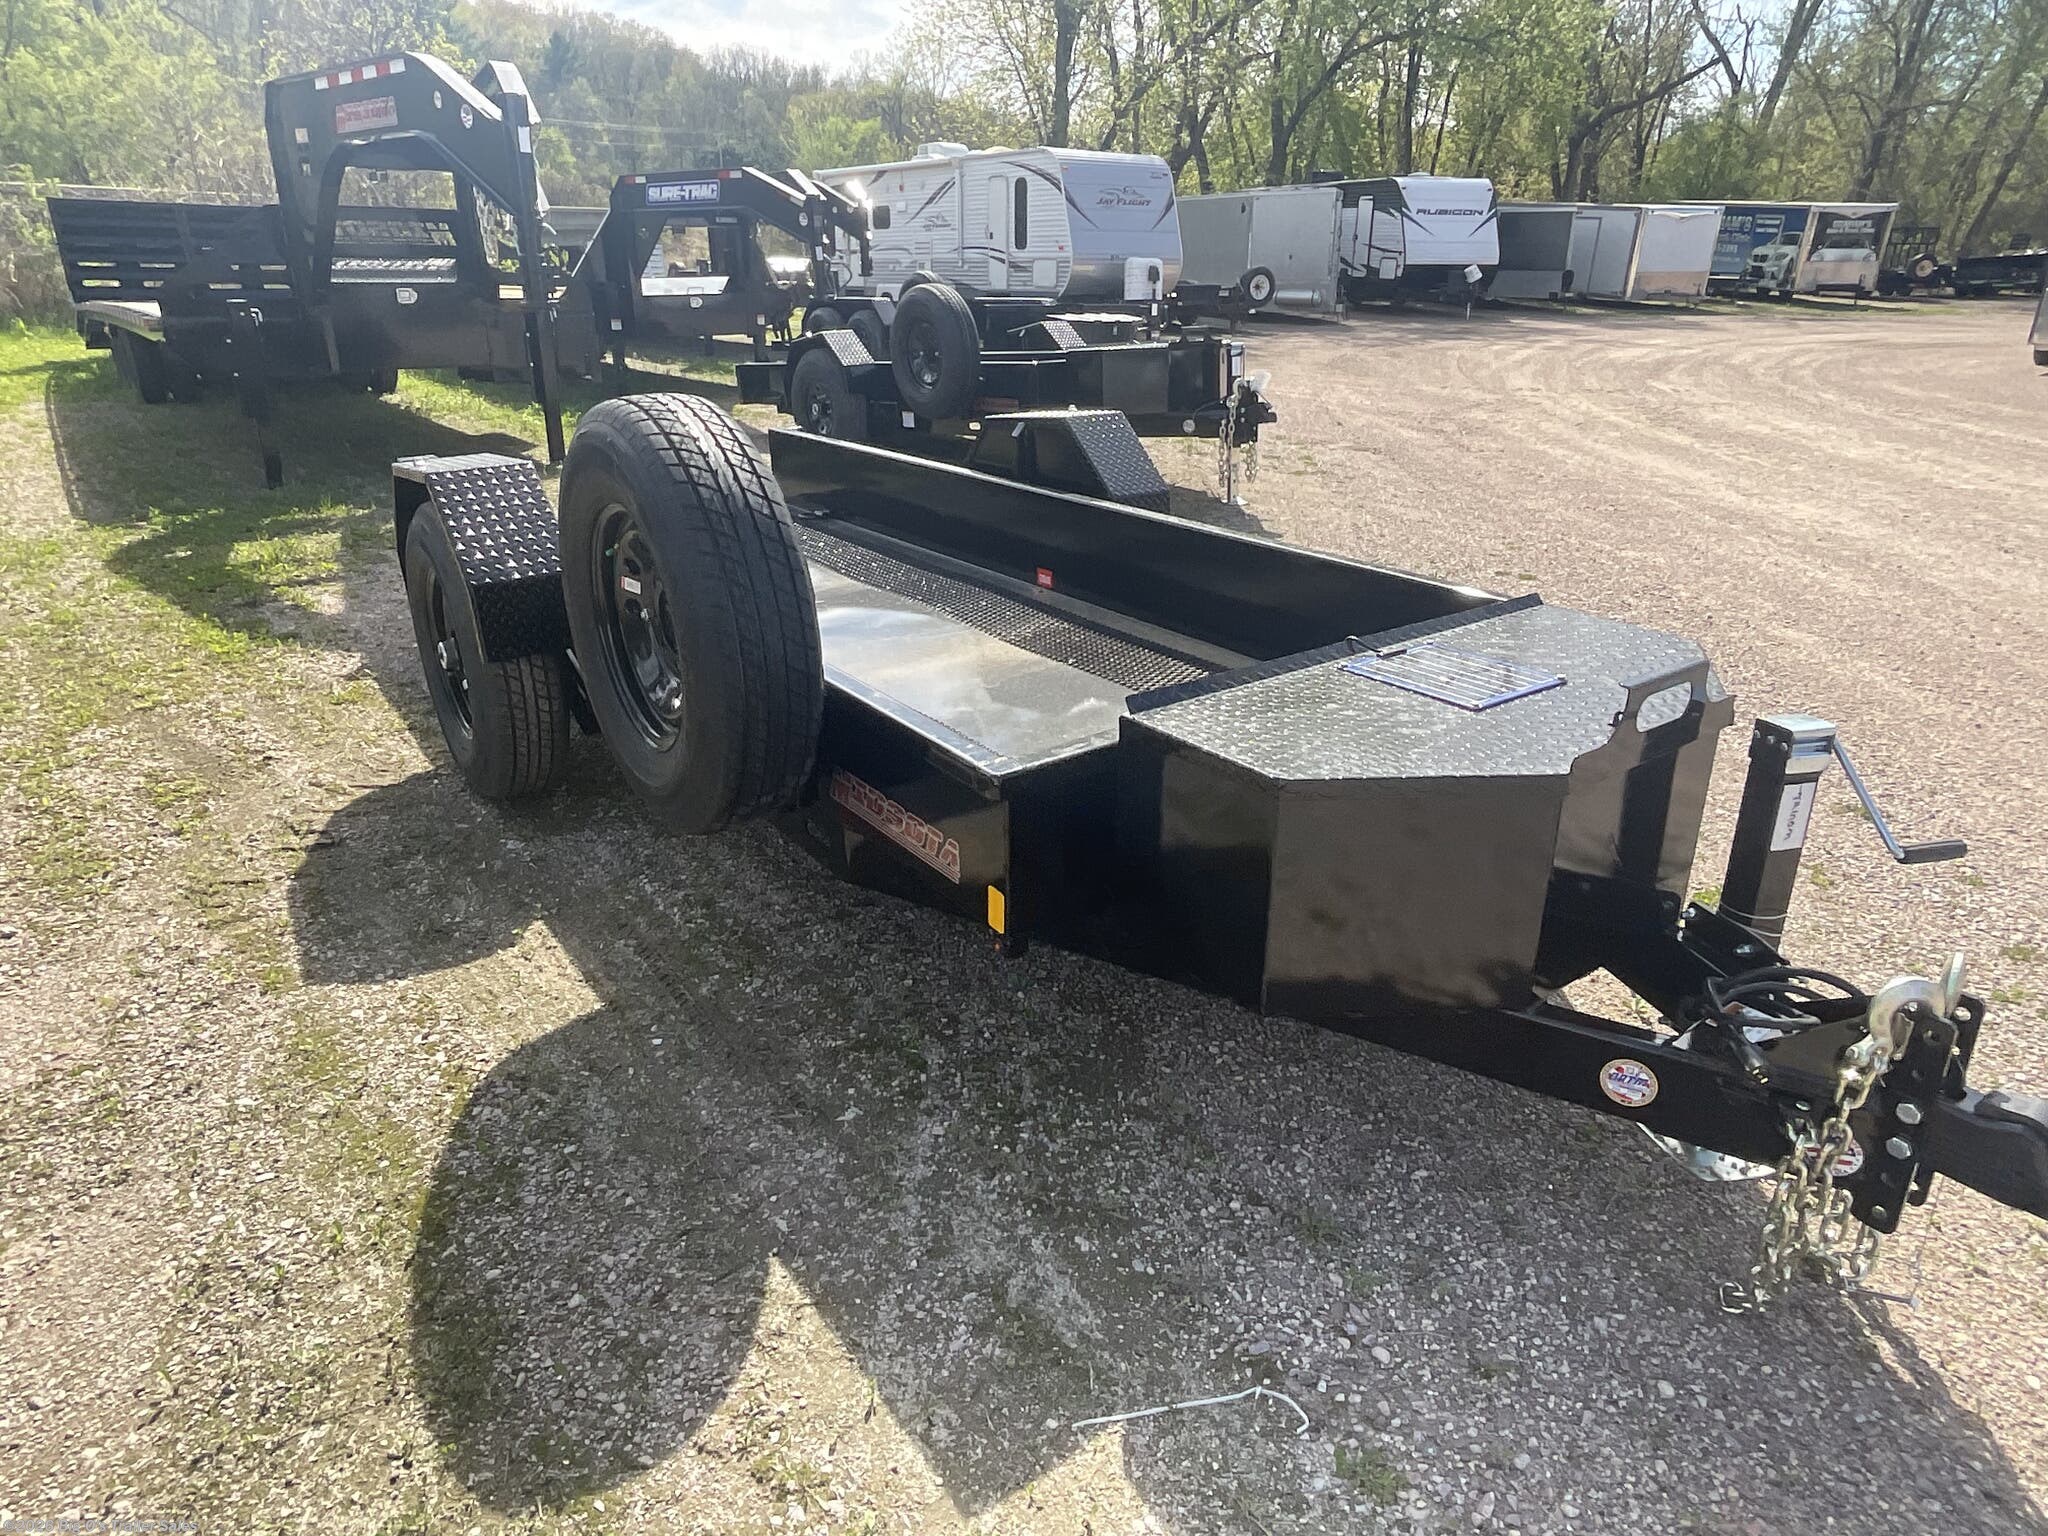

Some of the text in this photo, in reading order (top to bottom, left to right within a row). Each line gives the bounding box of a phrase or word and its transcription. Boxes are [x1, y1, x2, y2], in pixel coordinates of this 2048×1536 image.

[648, 183, 718, 201] SURE-TRAC
[1116, 198, 1152, 206] FLIGHT
[1416, 208, 1484, 216] RUBICON
